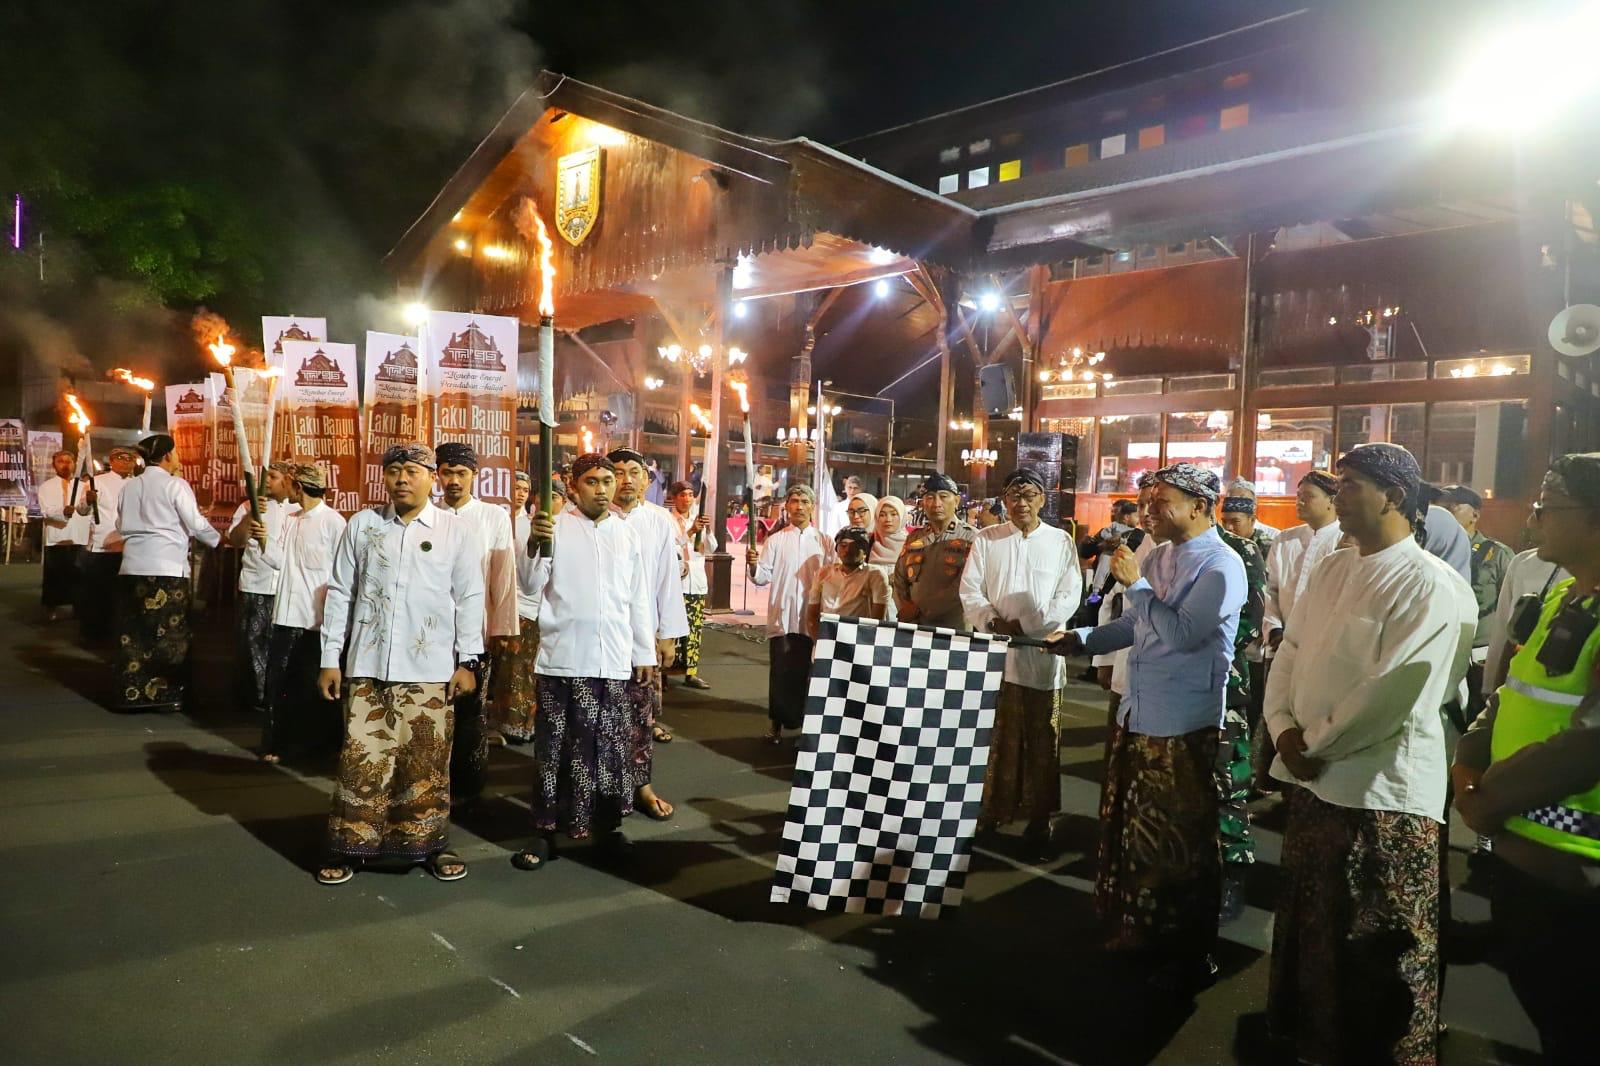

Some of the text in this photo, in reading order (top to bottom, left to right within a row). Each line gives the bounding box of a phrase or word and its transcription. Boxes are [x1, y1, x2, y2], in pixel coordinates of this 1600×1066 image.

[293, 414, 355, 438] Laku Banyu
[367, 410, 397, 435] Laku
[433, 403, 467, 430] Laku
[471, 404, 511, 434] Banyu
[295, 434, 356, 458] Penguripan
